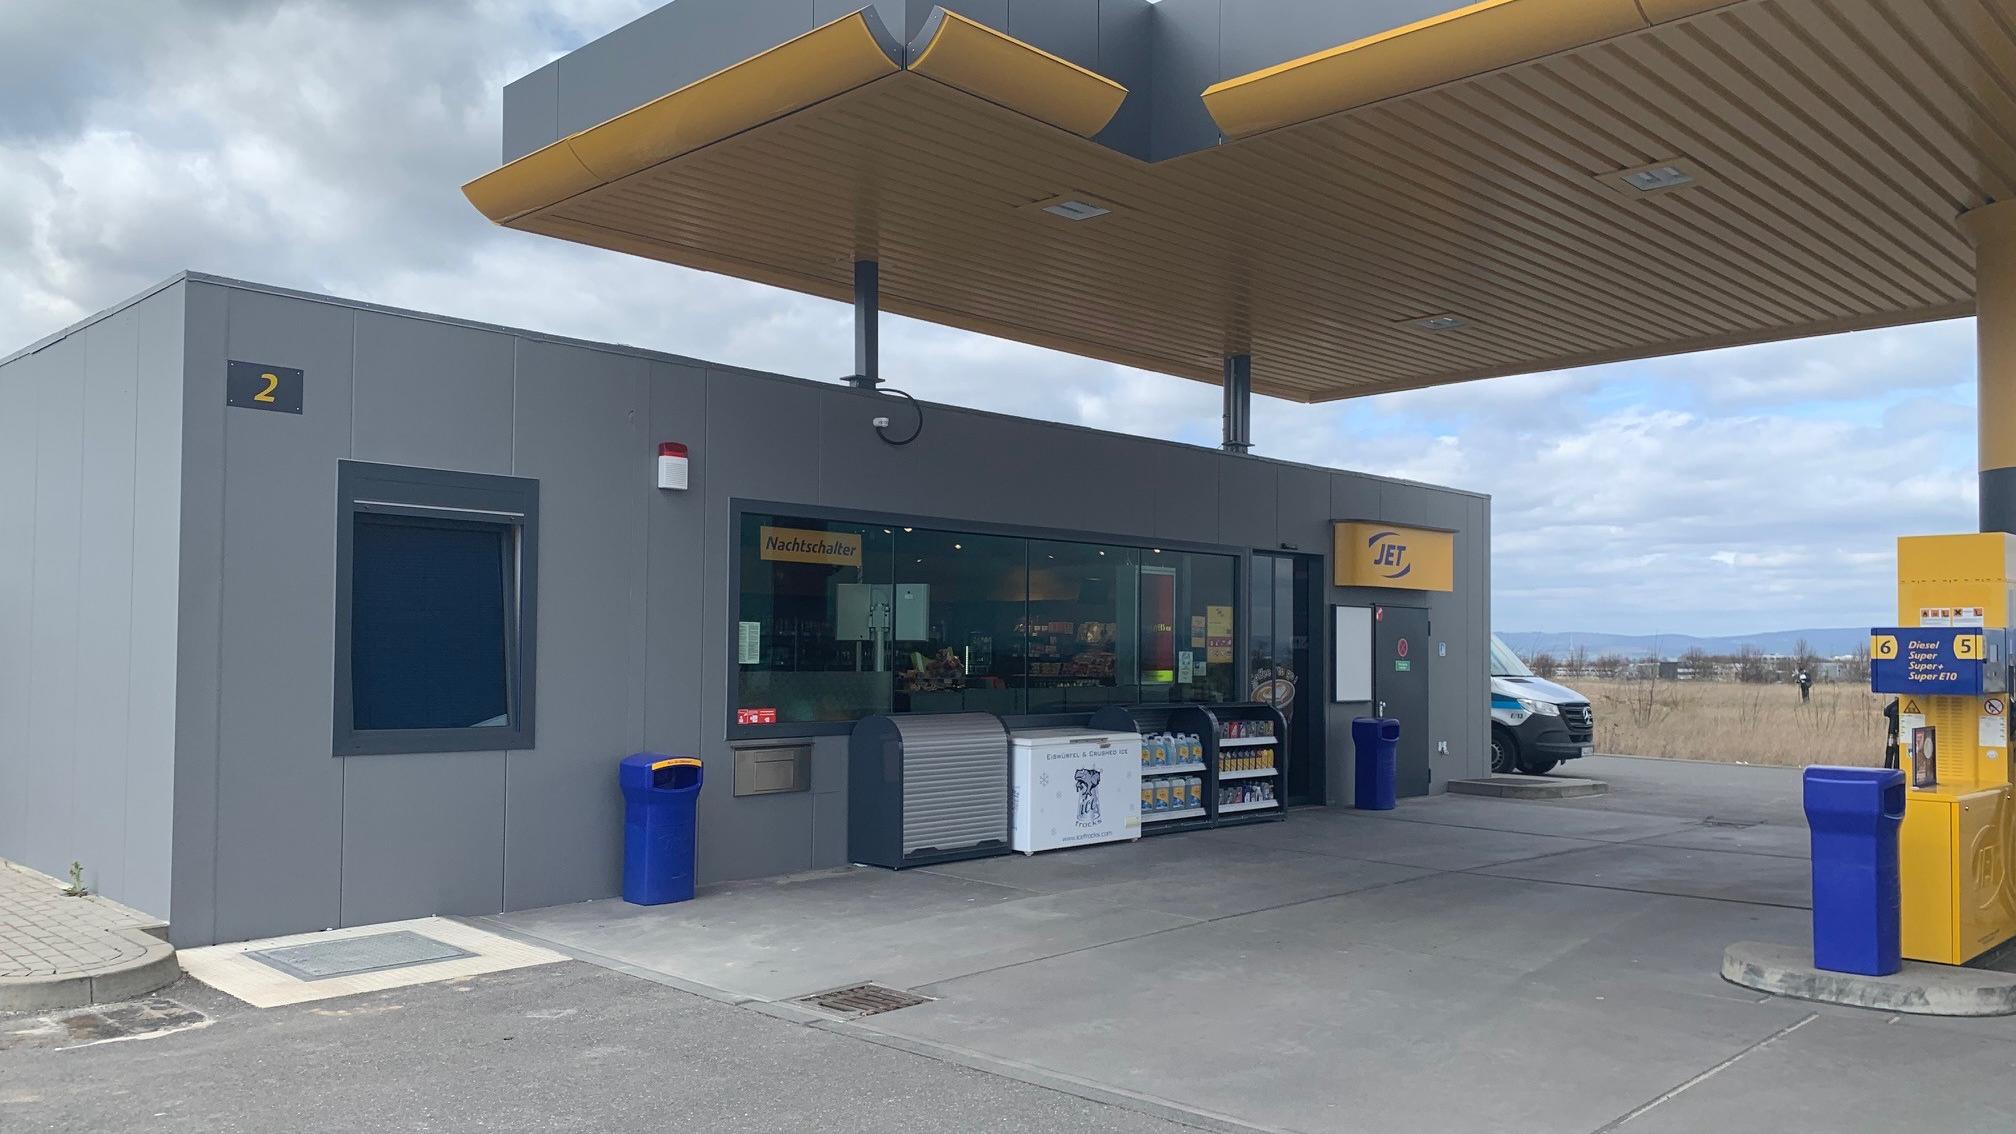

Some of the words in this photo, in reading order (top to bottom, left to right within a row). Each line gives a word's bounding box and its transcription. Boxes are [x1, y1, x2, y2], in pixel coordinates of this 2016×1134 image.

[253, 373, 278, 402] 2
[766, 536, 856, 556] Nachtschalter
[1373, 543, 1407, 566] JET
[1880, 640, 1891, 654] 6
[1908, 641, 1940, 650] Diesel
[1960, 639, 1971, 653] 5
[1908, 652, 1938, 661] Super
[1908, 662, 1944, 671] Super+
[1908, 672, 1938, 682] Super
[1939, 672, 1957, 681] E10
